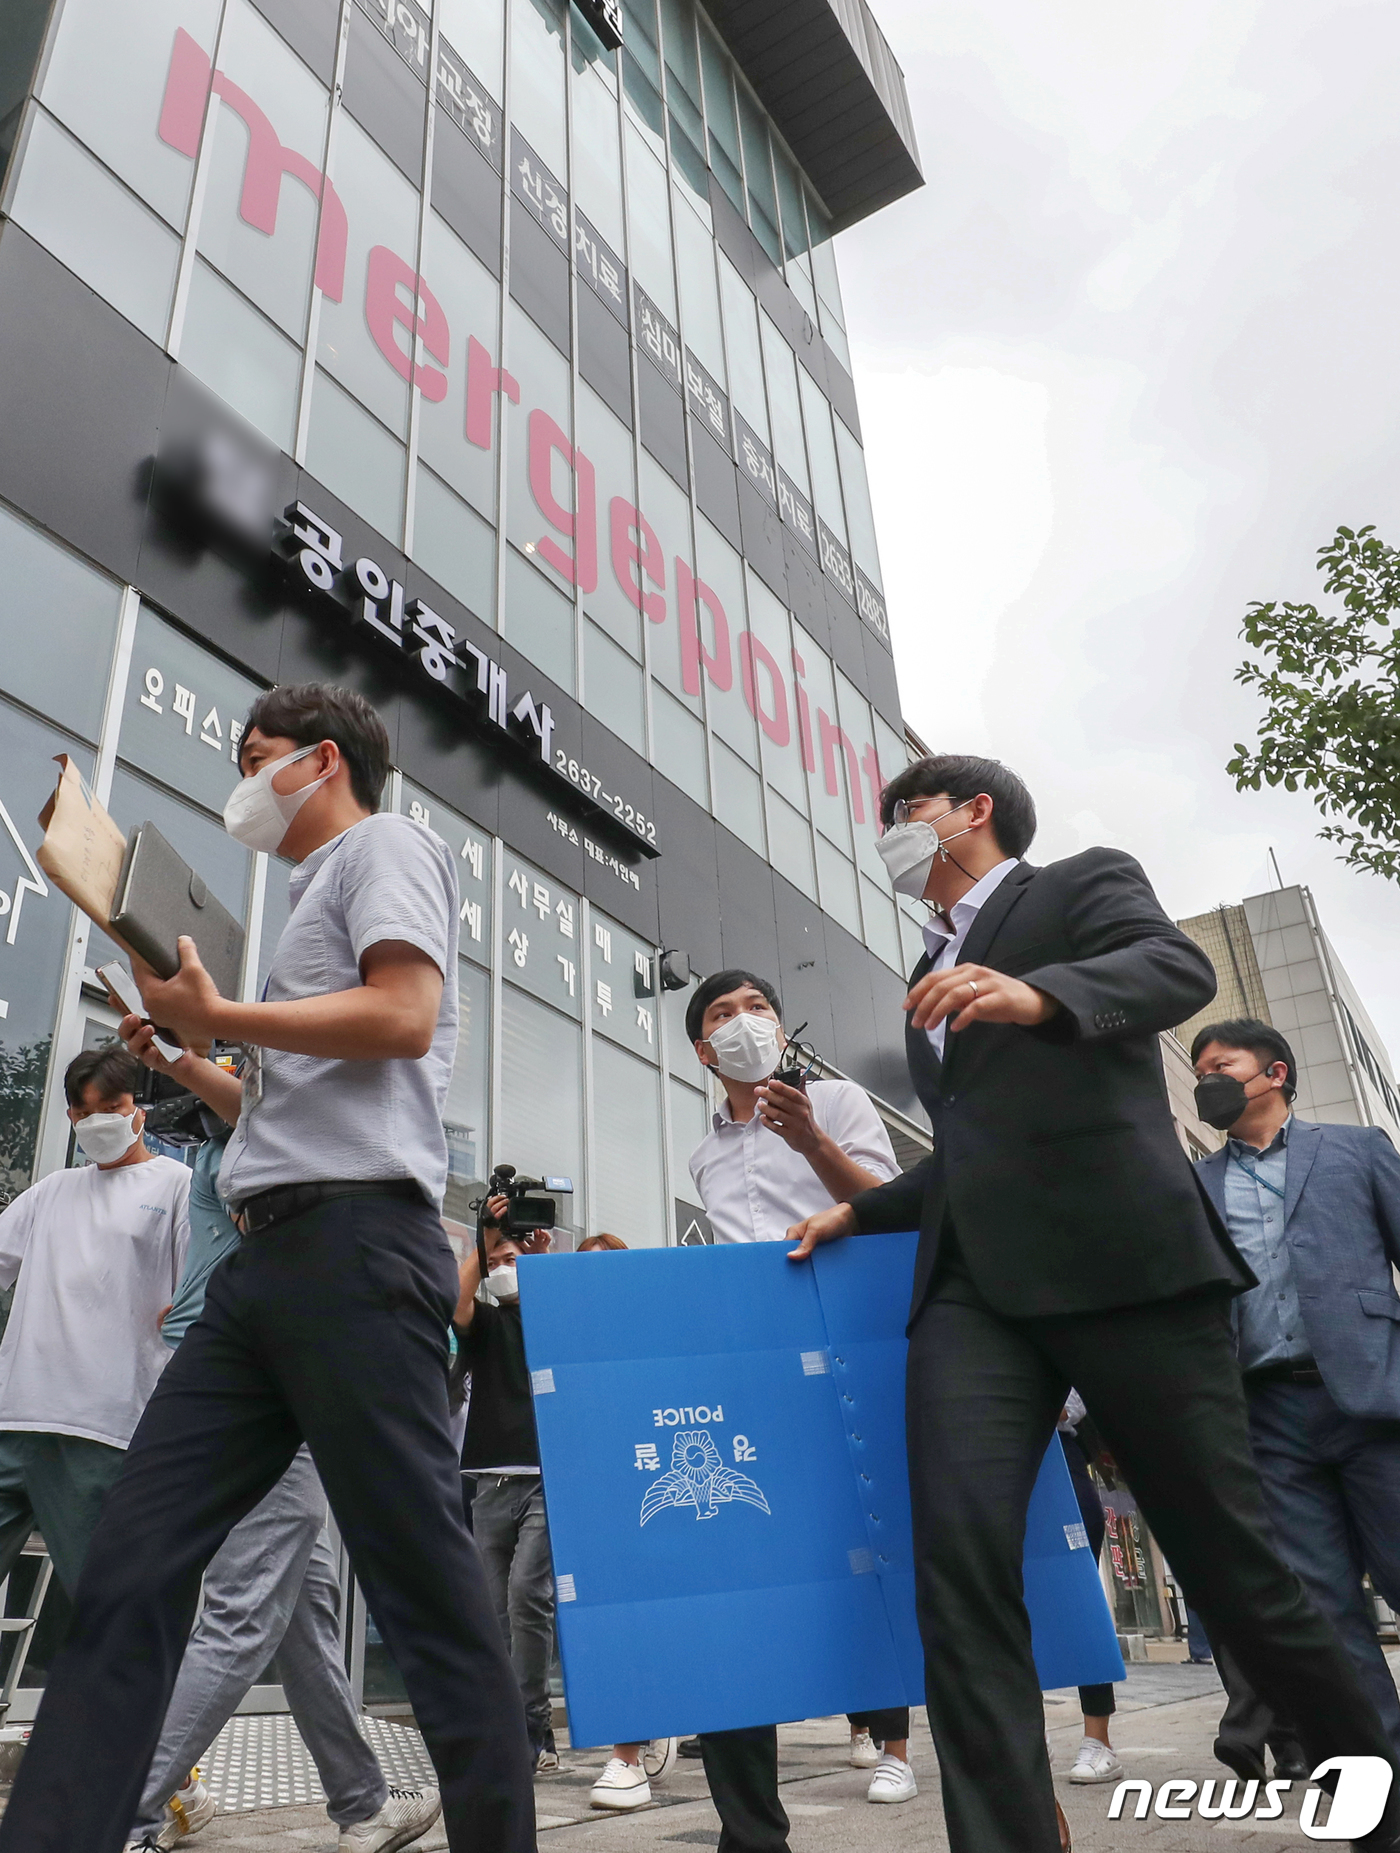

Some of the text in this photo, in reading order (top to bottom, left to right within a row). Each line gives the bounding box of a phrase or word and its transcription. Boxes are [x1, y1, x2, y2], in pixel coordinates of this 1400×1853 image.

[293, 500, 555, 766] 공인중개사
[546, 811, 579, 847] 사무소
[556, 749, 657, 846] 2637-2252
[508, 868, 574, 939] 사무실
[652, 1405, 724, 1427] POLICE
